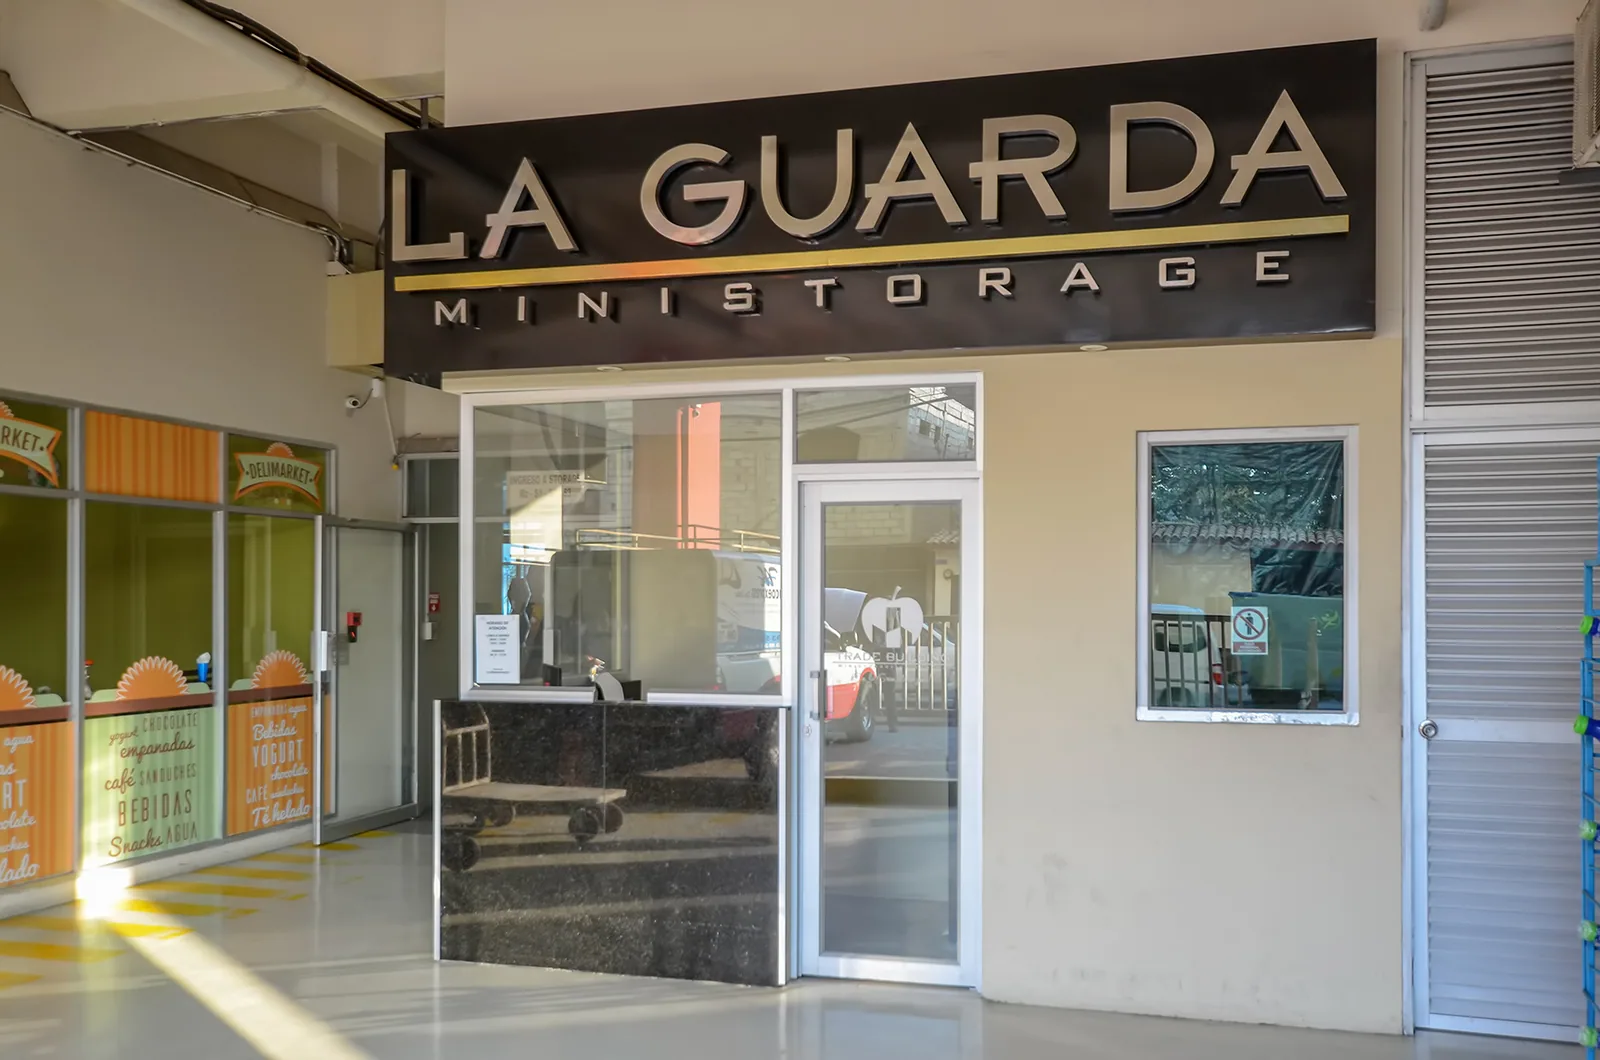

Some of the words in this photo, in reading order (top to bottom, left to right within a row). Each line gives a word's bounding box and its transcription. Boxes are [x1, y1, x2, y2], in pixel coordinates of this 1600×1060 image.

[391, 156, 579, 263] LA
[640, 88, 1348, 247] GUARDA
[434, 250, 1291, 327] MINISTORAGE
[248, 461, 312, 486] DELIMARKET
[838, 652, 881, 662] TRADE
[3, 735, 35, 753] agua
[108, 726, 138, 746] yogurt
[142, 712, 198, 733] CHOCOLATE
[252, 719, 297, 741] Bebidas
[120, 731, 195, 764] empanadas
[252, 739, 304, 768] YOGURT
[104, 767, 136, 794] café
[139, 763, 198, 786] SANDUCHES
[270, 763, 310, 781] chocolate
[118, 789, 193, 827] BEBIDAS
[251, 806, 270, 827] Té
[272, 796, 311, 822] helado
[108, 828, 163, 857] Snacks
[165, 821, 198, 845] AGUA
